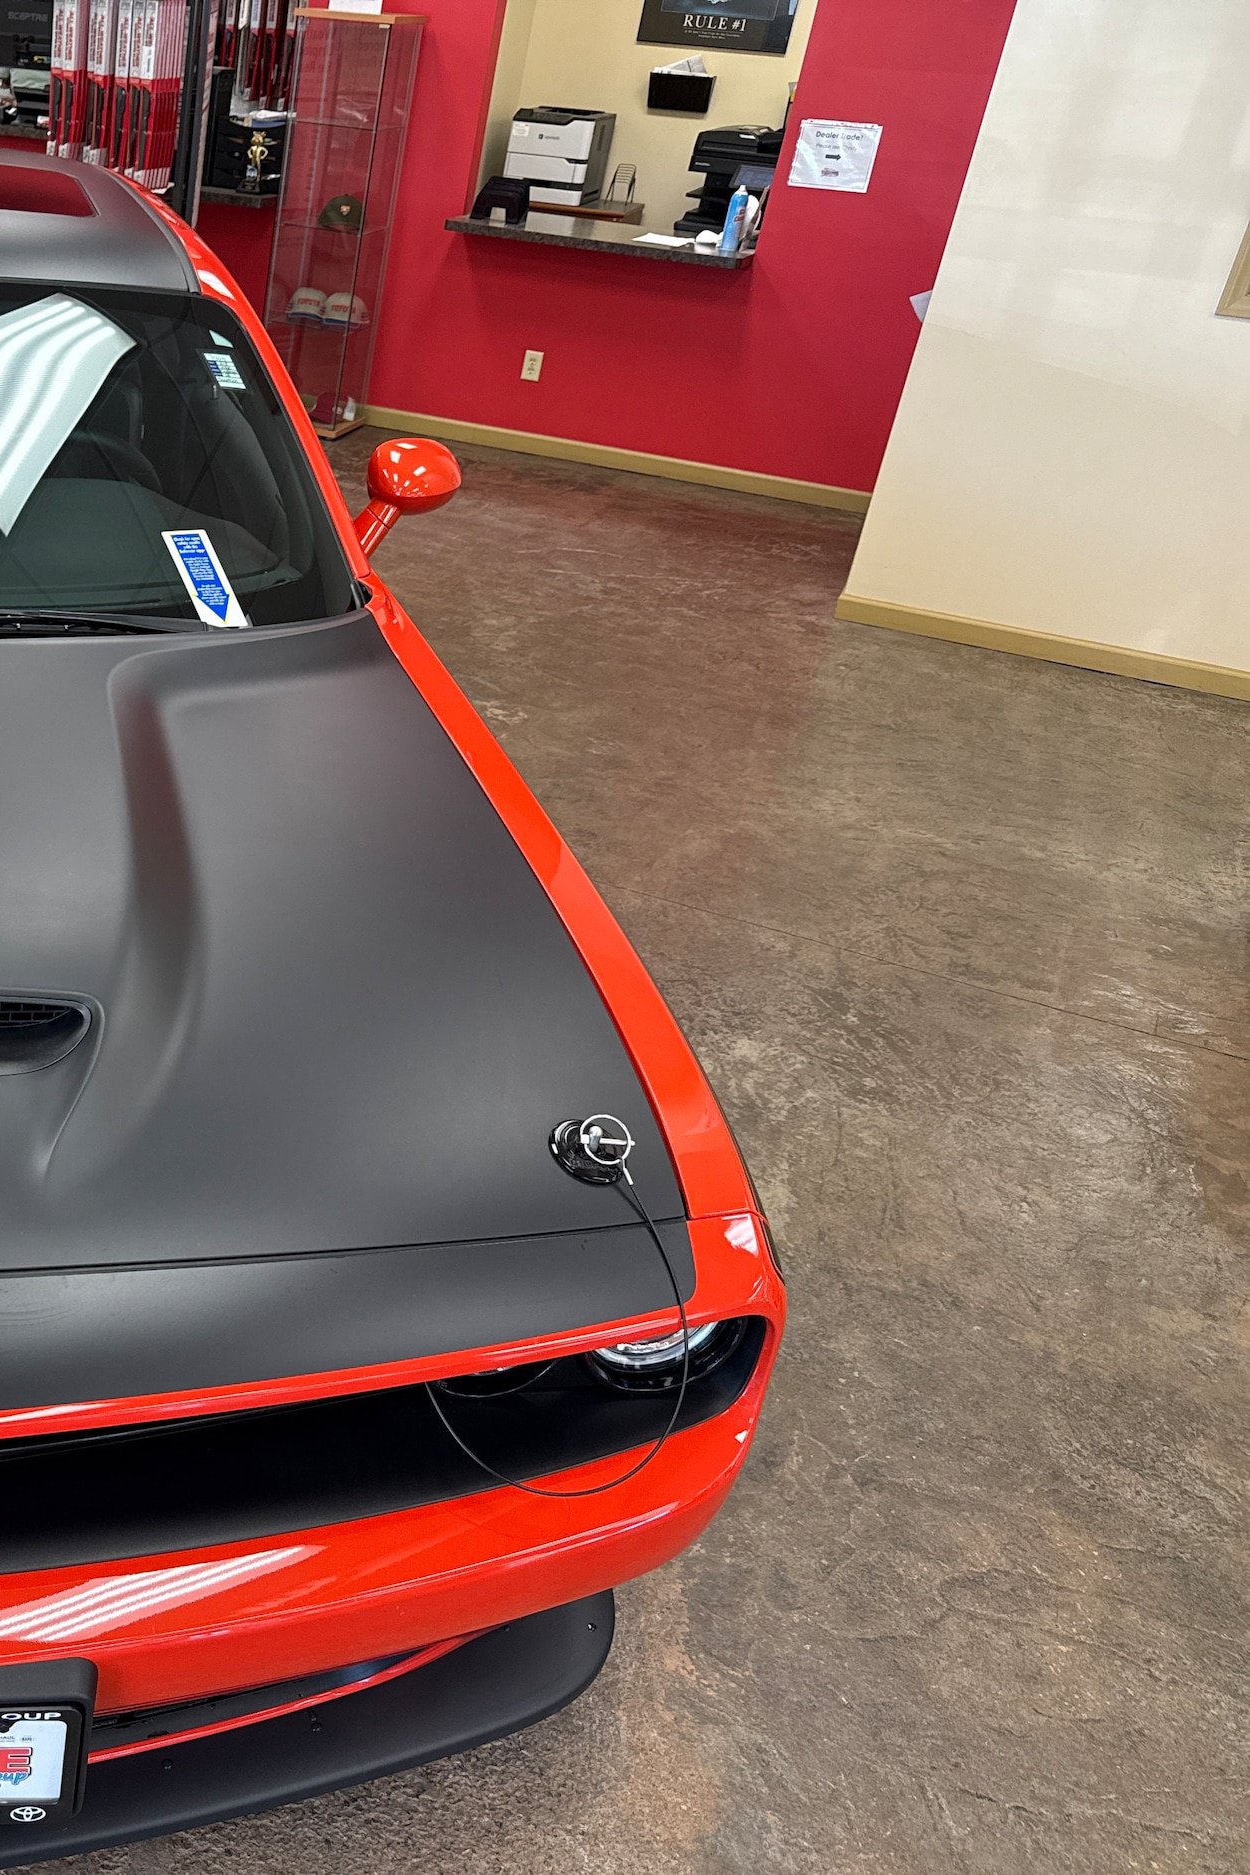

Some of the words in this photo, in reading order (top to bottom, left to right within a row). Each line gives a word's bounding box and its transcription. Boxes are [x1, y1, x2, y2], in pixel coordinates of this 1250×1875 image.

[683, 14, 728, 30] RULE
[732, 18, 747, 32] #1
[815, 131, 839, 139] Dealer
